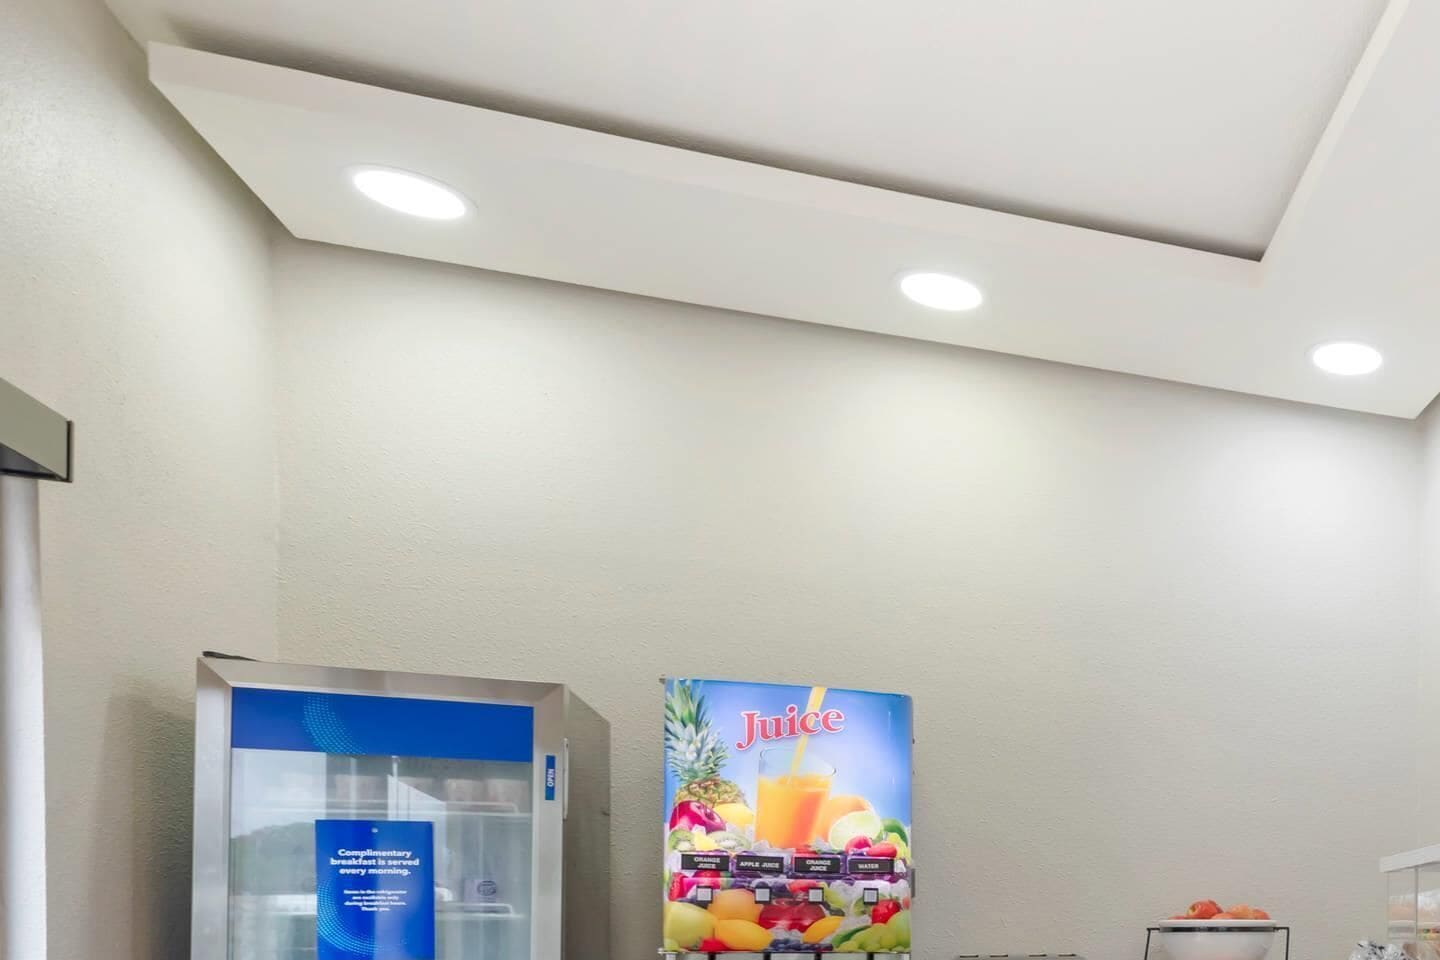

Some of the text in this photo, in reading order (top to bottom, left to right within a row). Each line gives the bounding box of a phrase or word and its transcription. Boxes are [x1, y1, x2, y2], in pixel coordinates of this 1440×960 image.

[735, 703, 845, 751] Juice
[546, 768, 555, 788] OPEN
[338, 849, 411, 858] Complimentary
[330, 857, 420, 866] breakfast is served
[694, 856, 721, 864] ORANGE
[739, 861, 760, 869] APPLE
[858, 862, 880, 870] WATER
[339, 867, 411, 877] every morning.
